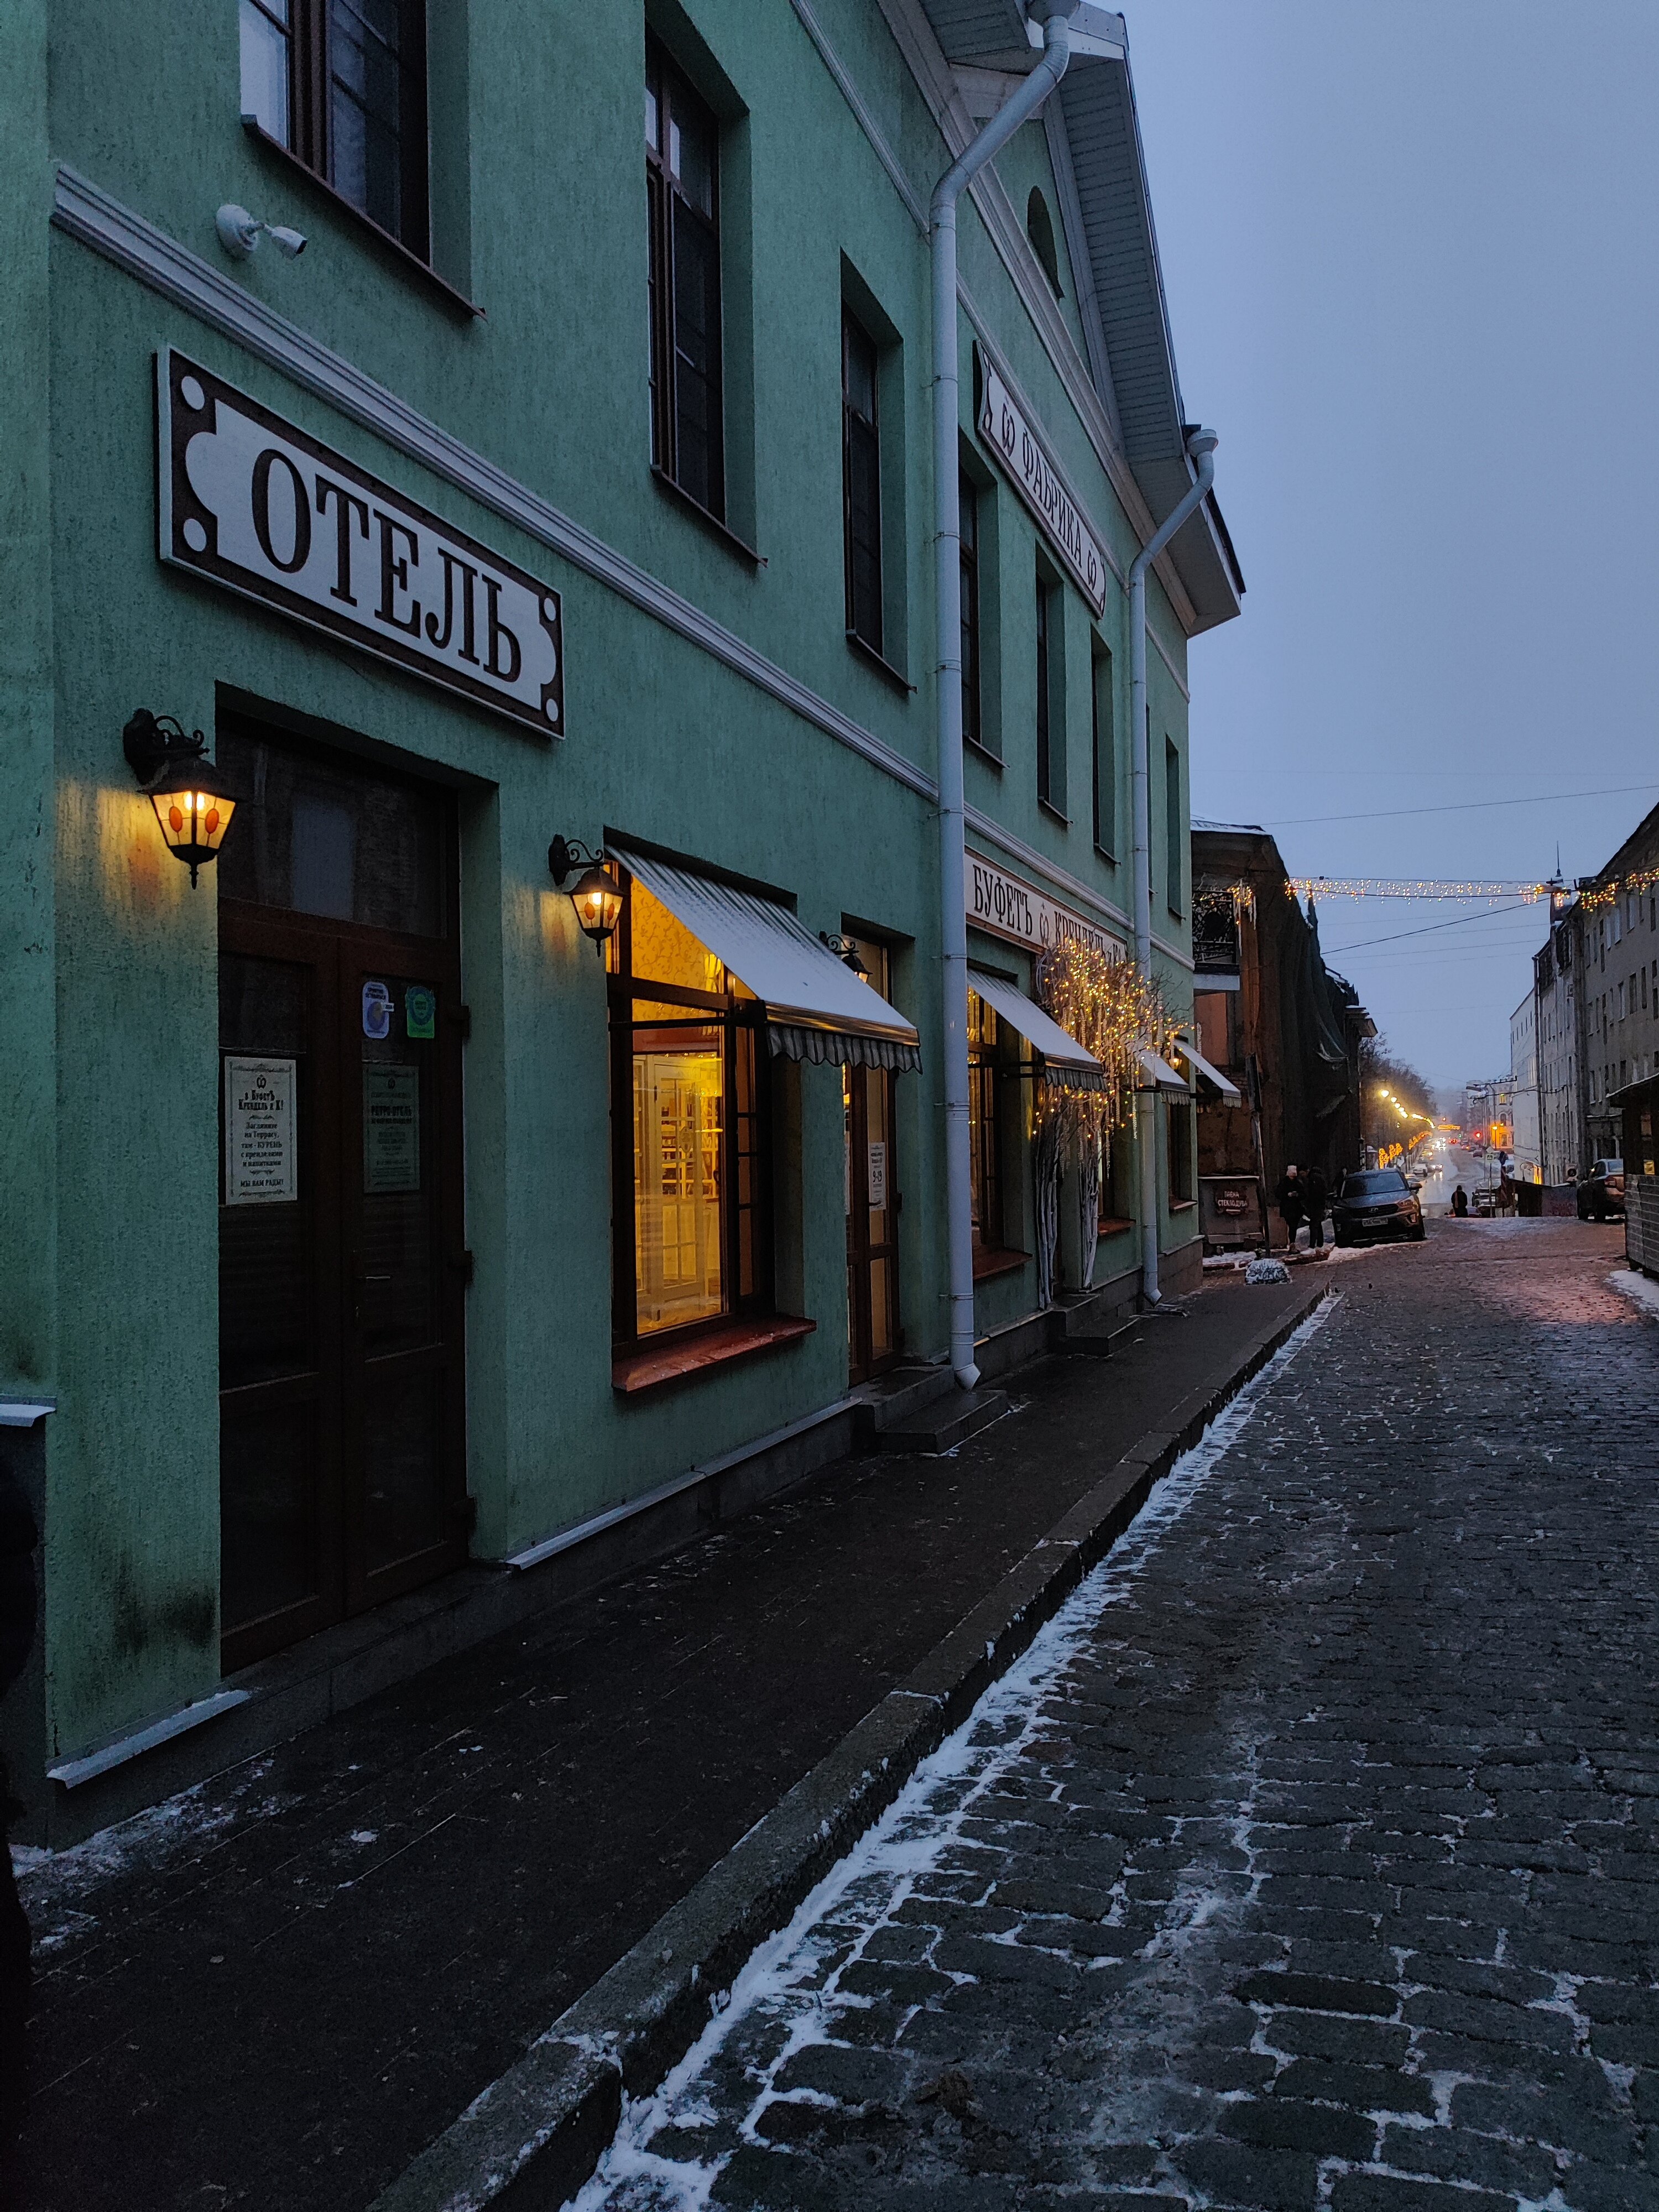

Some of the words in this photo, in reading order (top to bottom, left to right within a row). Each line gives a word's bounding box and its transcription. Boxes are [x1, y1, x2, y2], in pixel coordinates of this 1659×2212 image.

[252, 449, 521, 683] ОТЕЛЬ
[1022, 427, 1082, 568] ФАБРИКА
[973, 864, 1033, 936] БУФЕТЪ
